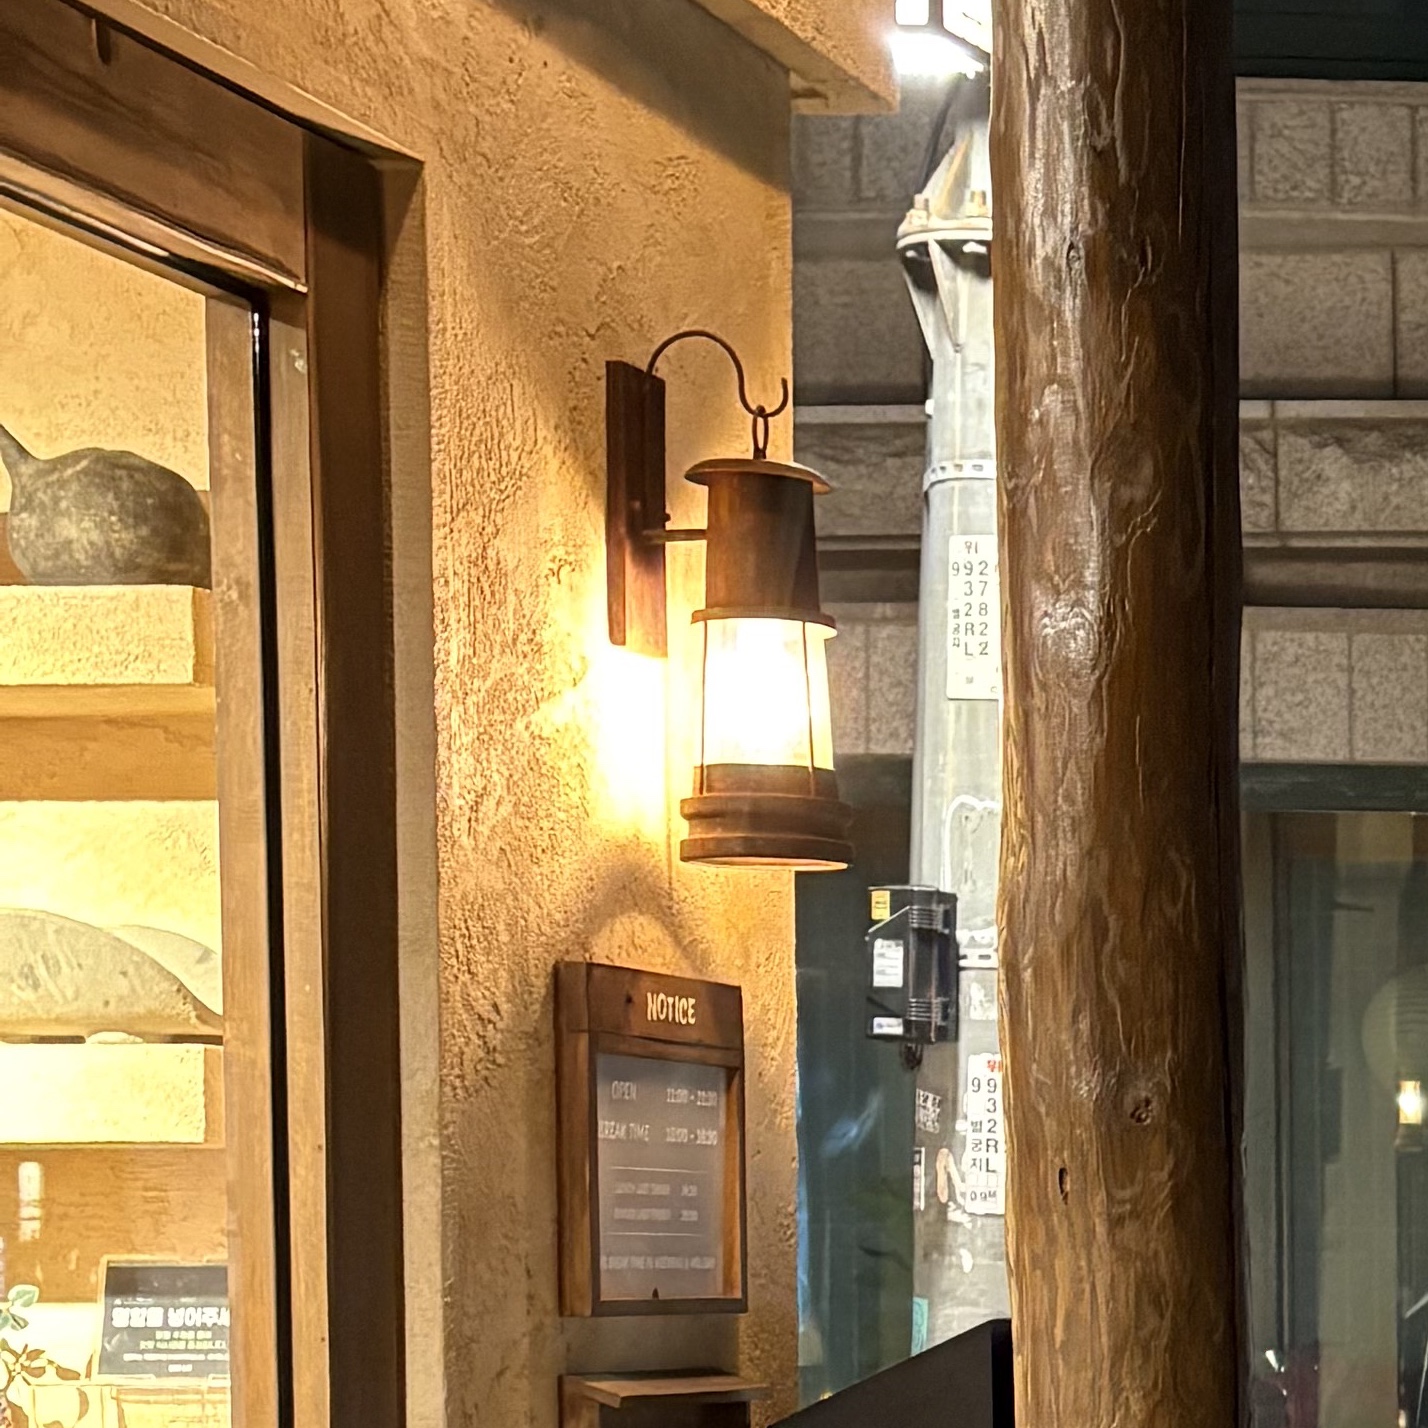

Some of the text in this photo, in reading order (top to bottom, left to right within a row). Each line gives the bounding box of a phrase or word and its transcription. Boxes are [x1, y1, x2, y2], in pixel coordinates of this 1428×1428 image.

[952, 560, 998, 576] 992
[646, 992, 697, 1025] NOTICE
[611, 1080, 637, 1100] OPEN
[629, 1121, 650, 1142] TIME
